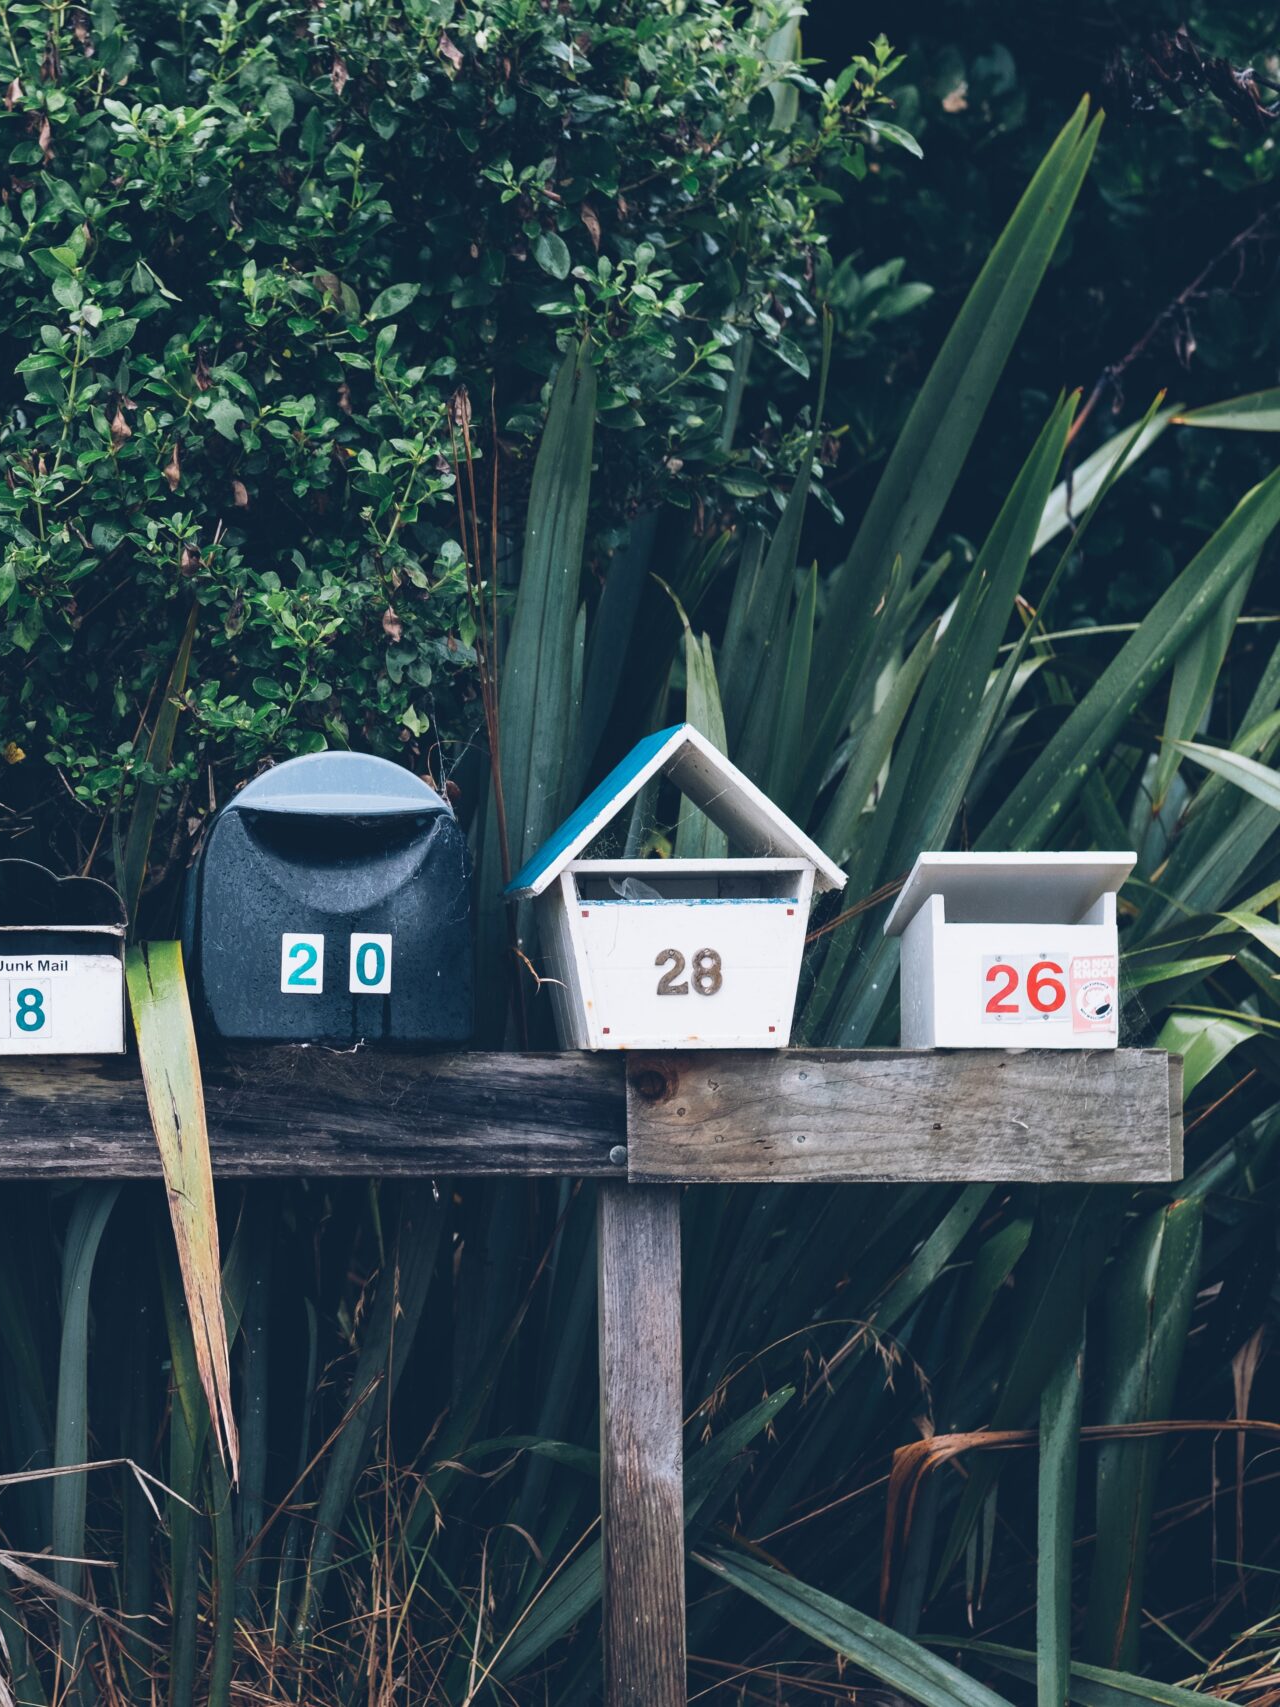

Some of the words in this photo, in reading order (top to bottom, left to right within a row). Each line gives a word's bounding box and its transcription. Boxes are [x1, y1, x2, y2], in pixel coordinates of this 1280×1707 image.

[37, 960, 69, 972] Mail
[287, 942, 386, 987] 20
[654, 947, 723, 997] 28
[1073, 959, 1090, 969] DO
[985, 961, 1067, 1014] 26
